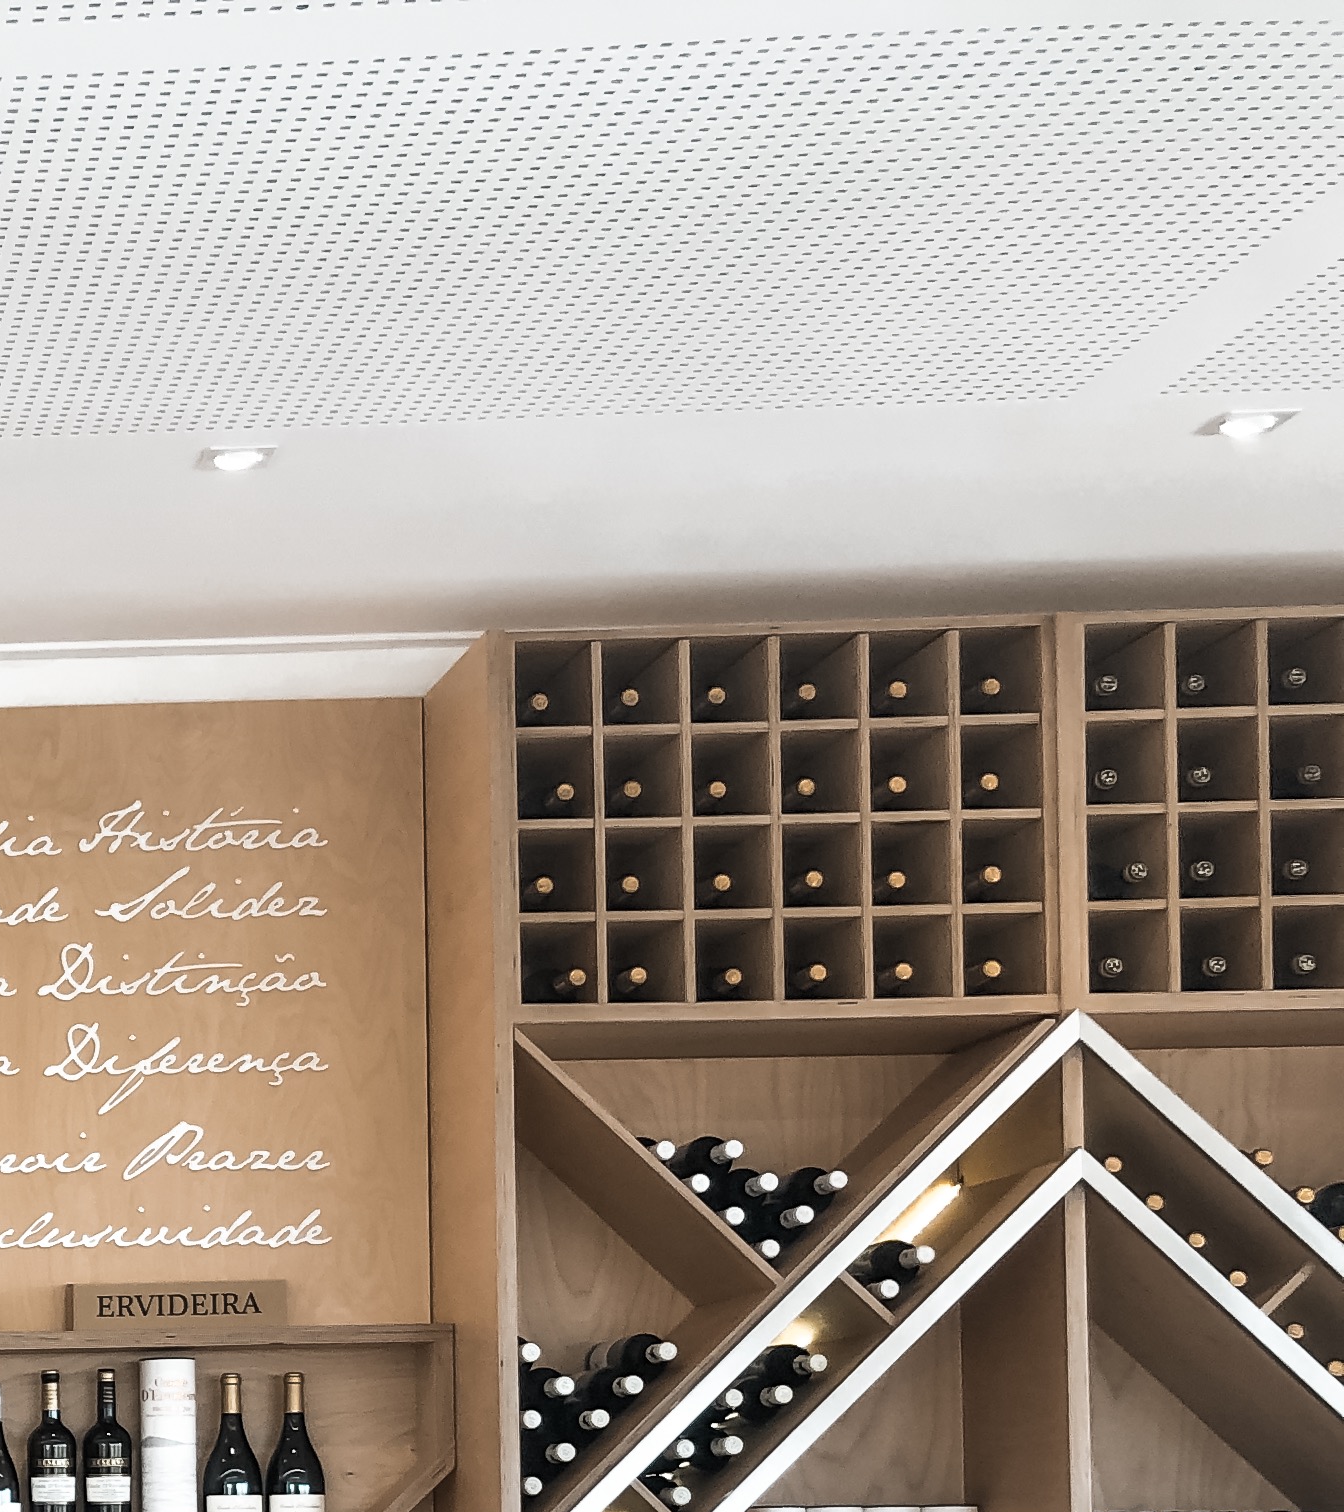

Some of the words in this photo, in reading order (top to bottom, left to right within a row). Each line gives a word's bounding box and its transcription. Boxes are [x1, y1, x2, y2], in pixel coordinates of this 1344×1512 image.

[78, 801, 328, 852] História
[95, 867, 328, 921] Solidez
[38, 943, 328, 1006] Distinção
[44, 1023, 329, 1115] Diferença
[124, 1121, 330, 1181] Prazer
[96, 1292, 263, 1318] ERVIDEIRA
